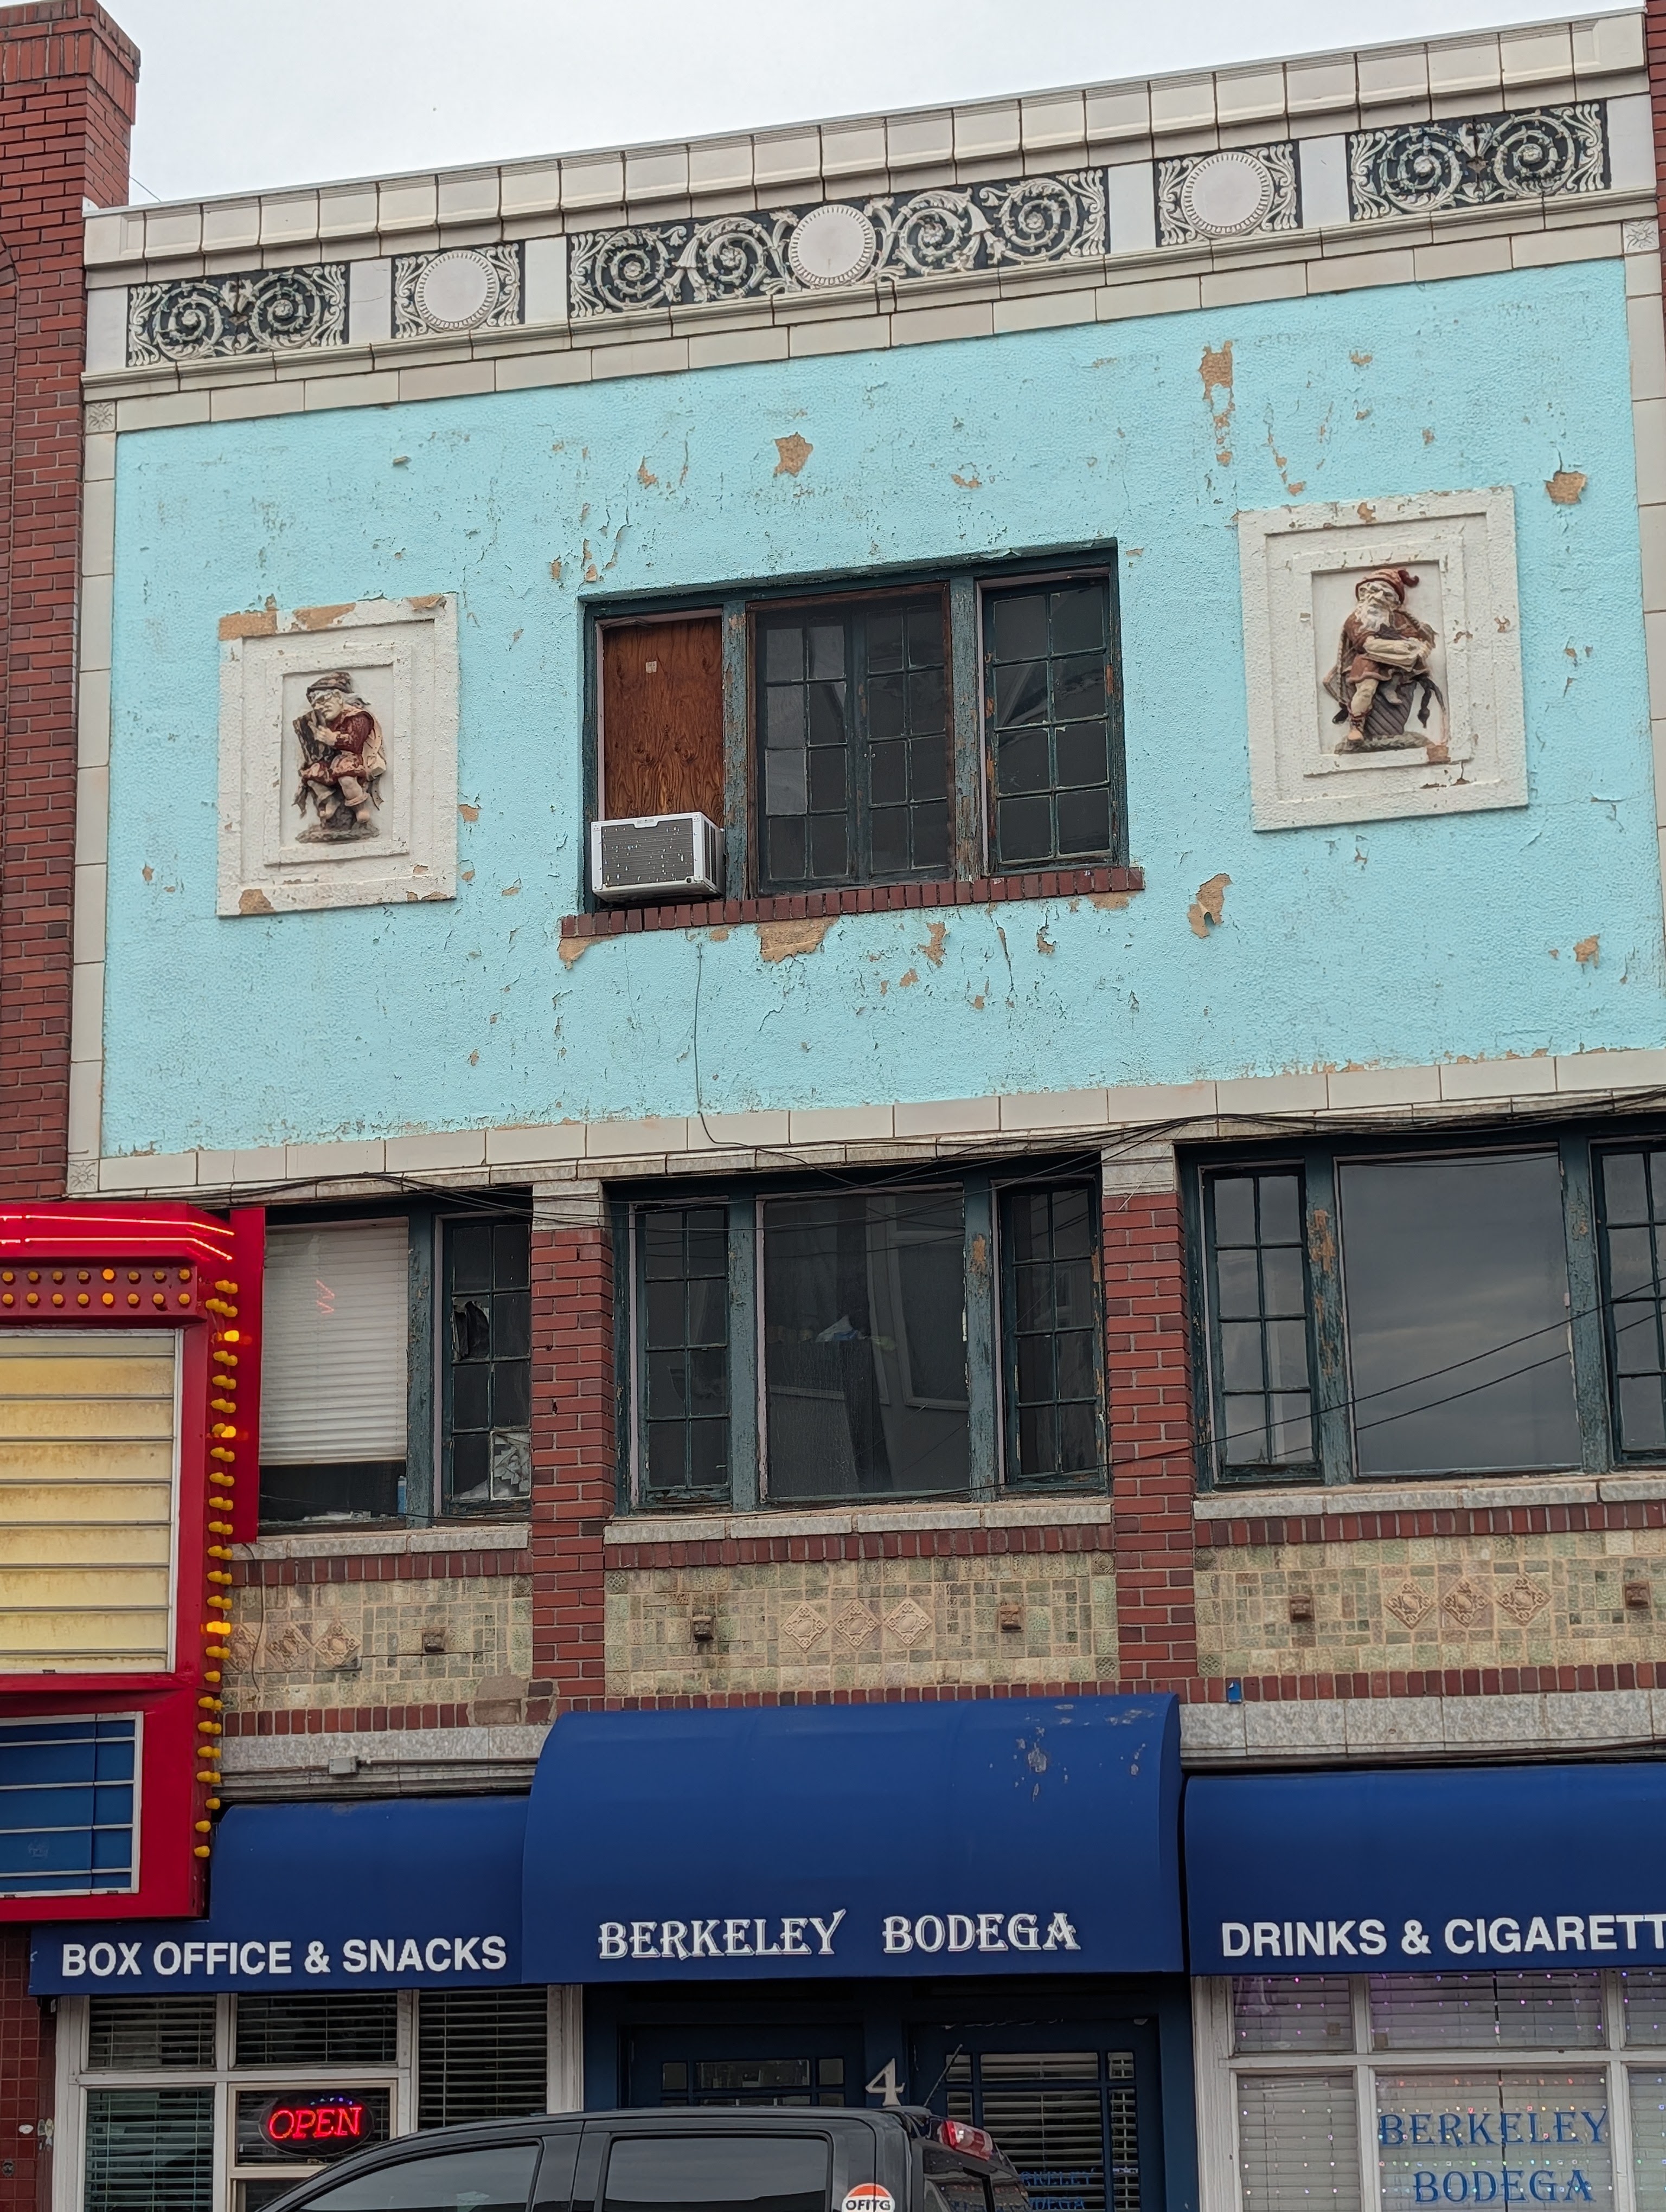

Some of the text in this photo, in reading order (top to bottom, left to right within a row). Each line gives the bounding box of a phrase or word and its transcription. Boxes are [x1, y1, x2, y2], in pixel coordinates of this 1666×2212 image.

[598, 1908, 1081, 1960] BERKELEY BODEGA
[1222, 1914, 1666, 1956] DRINKS & CIGARETT
[62, 1936, 507, 1976] BOX OFFICE & SNACKS
[270, 2107, 362, 2139] OPEN
[1379, 2108, 1607, 2147] BERKELEY
[1413, 2169, 1595, 2204] BODEGA
